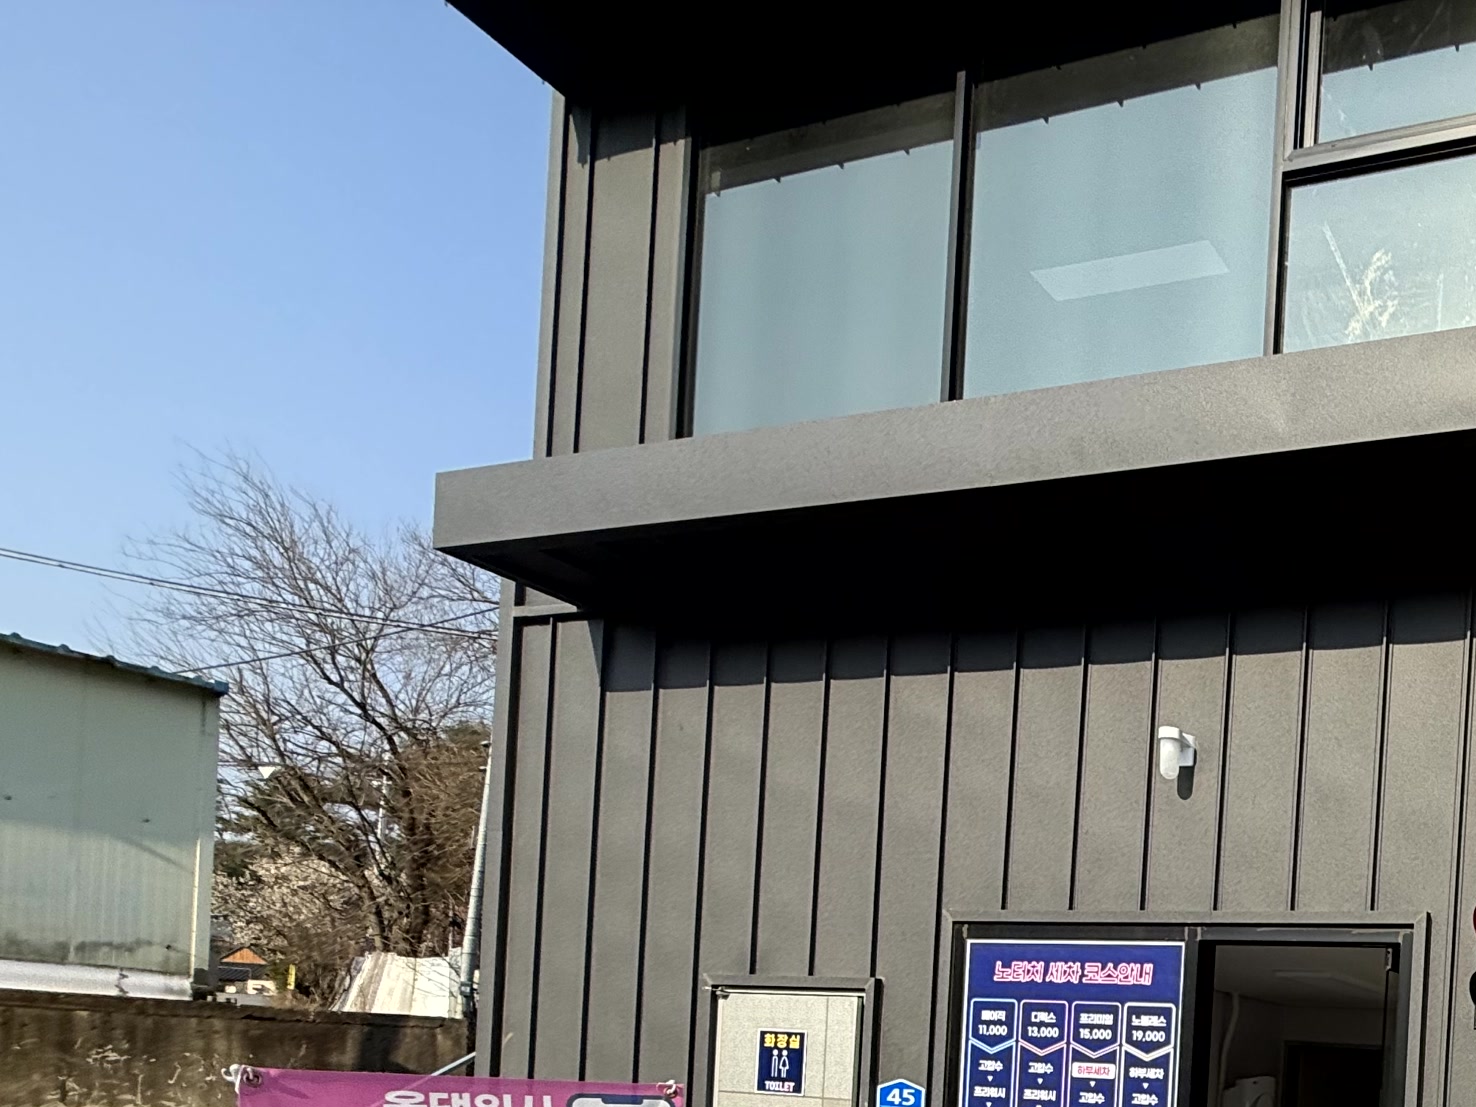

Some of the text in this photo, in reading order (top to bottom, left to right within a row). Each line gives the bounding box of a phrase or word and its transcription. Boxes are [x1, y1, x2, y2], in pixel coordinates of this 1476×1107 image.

[993, 961, 1154, 986] 노터치 세차 코스안내
[1079, 1013, 1114, 1025] 프리미엄
[978, 1024, 1008, 1037] 11,000
[1027, 1026, 1059, 1038] 13,000
[1079, 1028, 1112, 1041] 15,000
[1131, 1030, 1166, 1043] 19,000
[763, 1033, 801, 1049] 화장실
[1077, 1064, 1111, 1077] 하부세차
[764, 1080, 795, 1092] TOILET
[886, 1088, 916, 1106] 45
